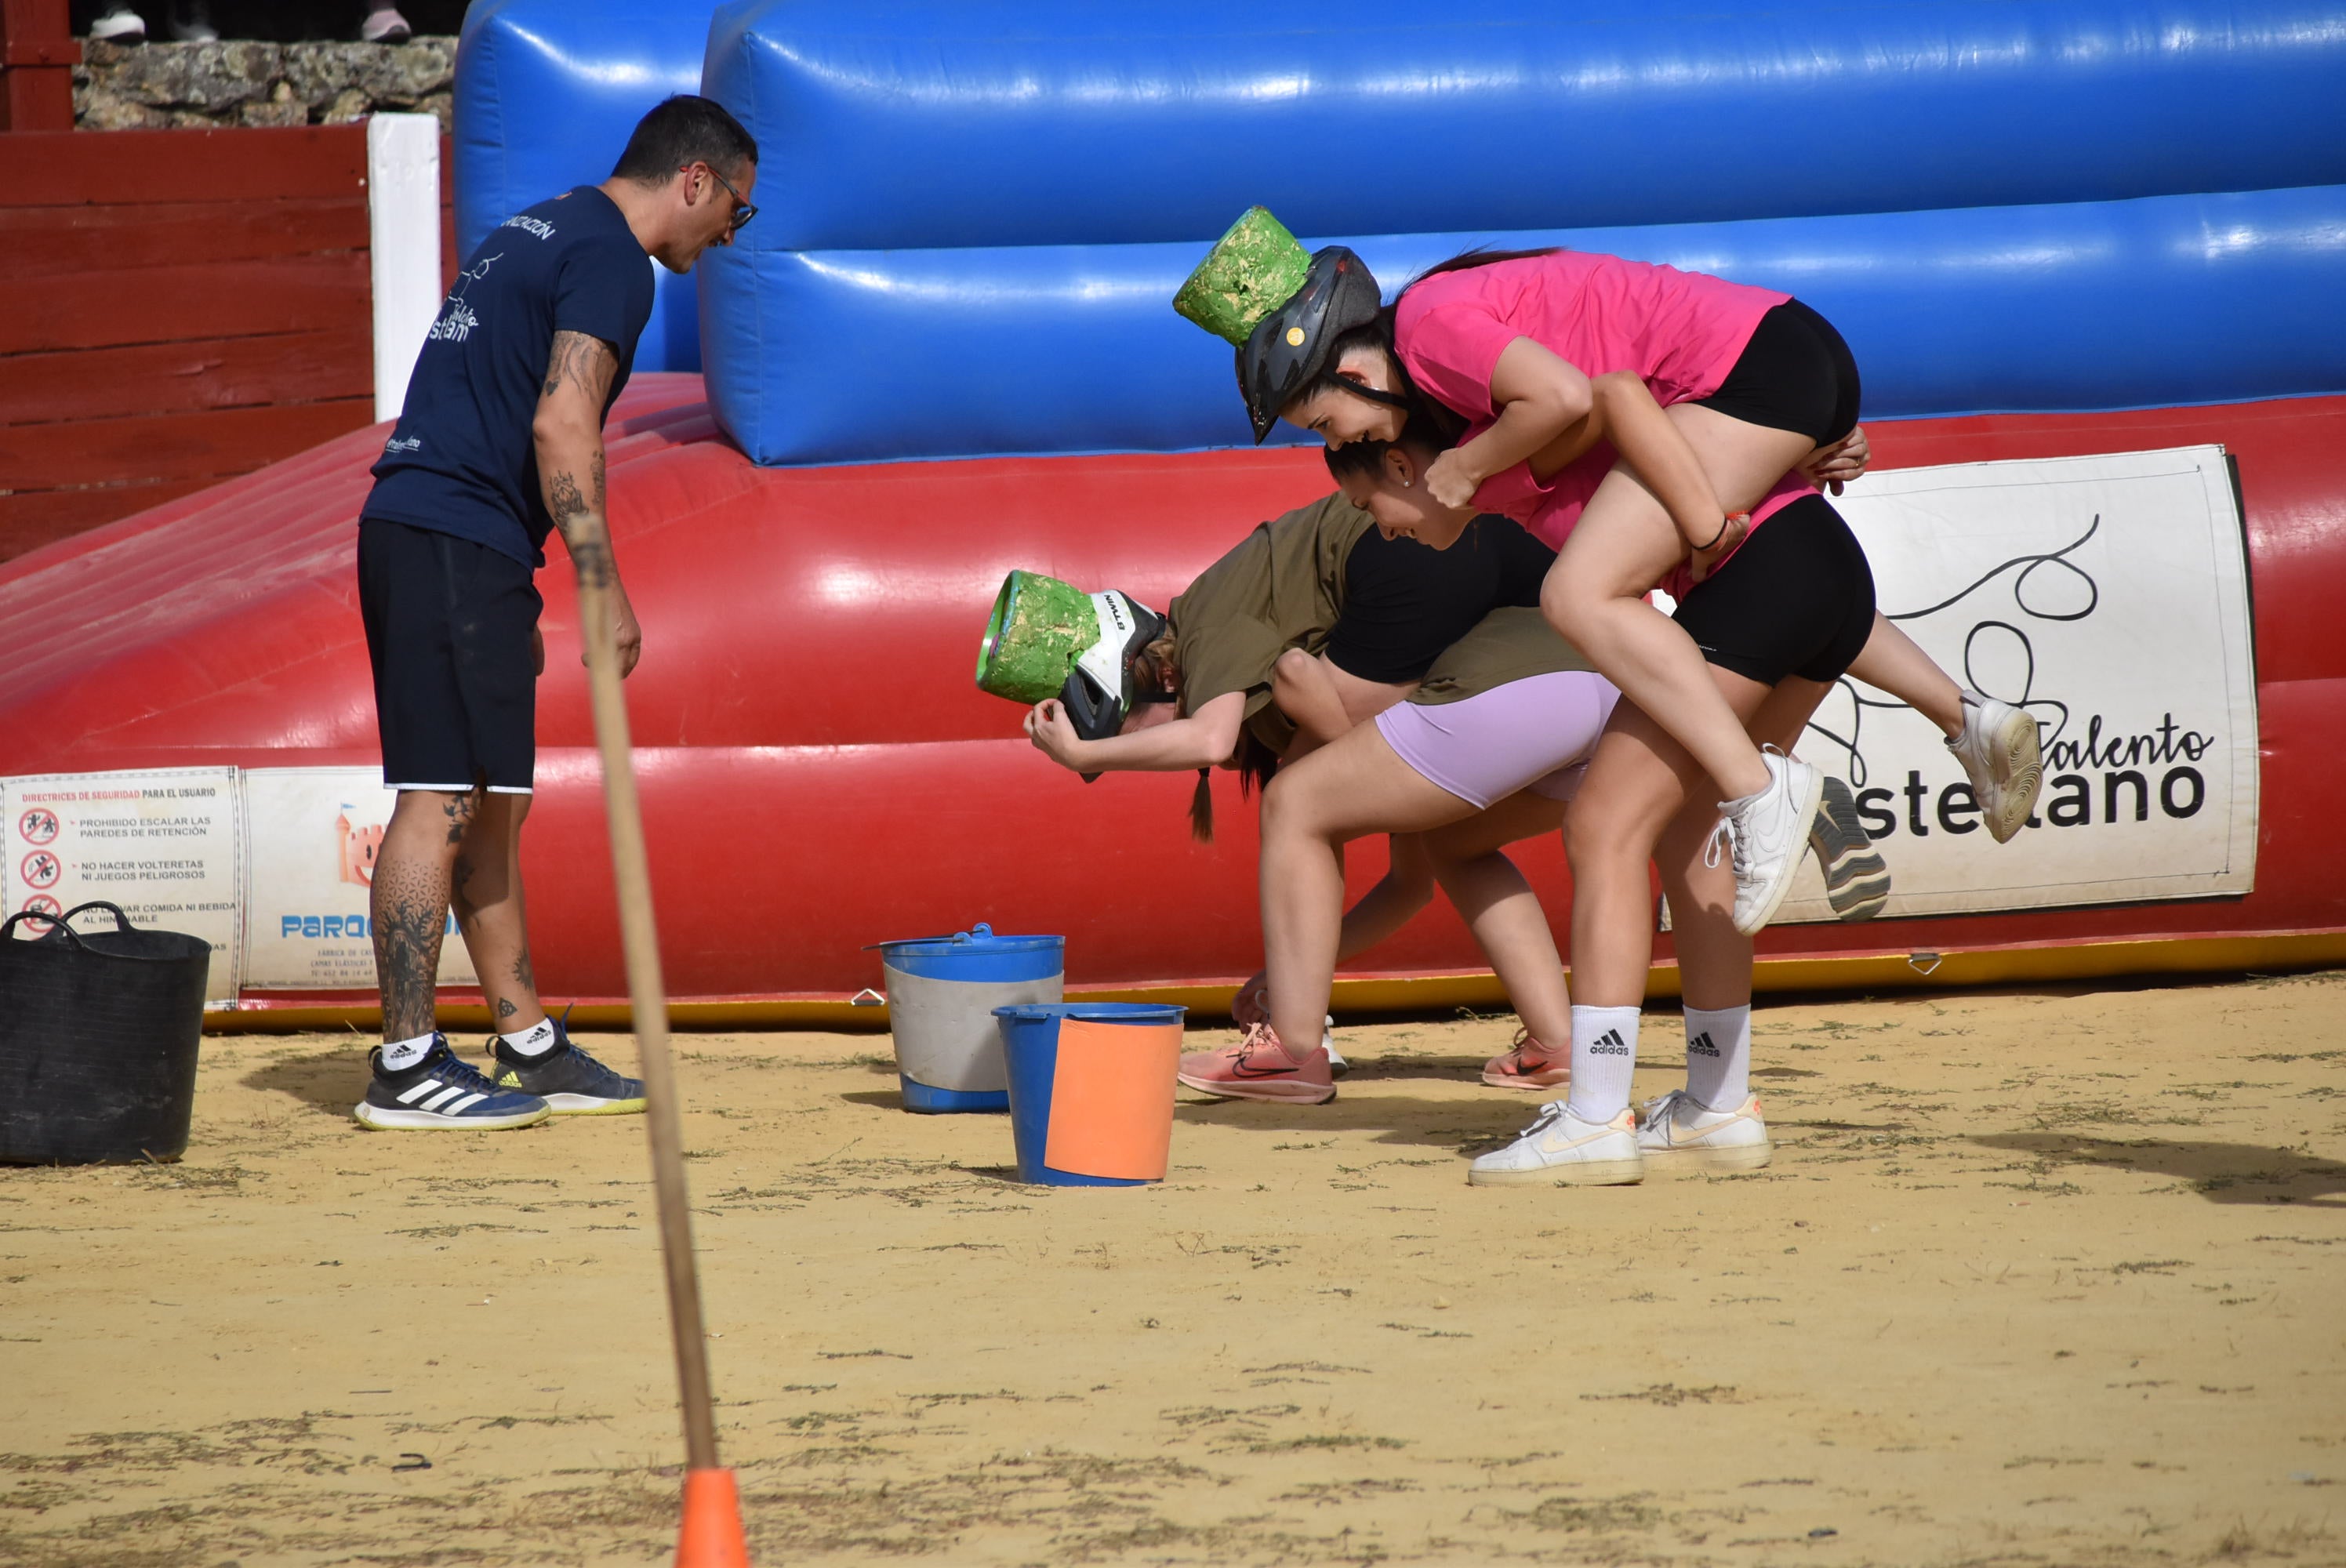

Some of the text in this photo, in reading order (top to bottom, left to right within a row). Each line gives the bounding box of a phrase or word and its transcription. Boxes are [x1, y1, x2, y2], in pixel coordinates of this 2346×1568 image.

[22, 787, 216, 803] DIRECTRICES DE SEGURIDAD PARA EL USUARIO
[1854, 765, 2206, 840] steano
[79, 816, 211, 828] PROHIBIDO ESCALAR LAS
[80, 826, 206, 838] PAREDES DE RETENCIÓN
[82, 860, 204, 870] NO HACER VOLTERETAS
[95, 872, 136, 880] JUEGOS
[140, 870, 205, 880] PELIGROSOS
[143, 903, 183, 913] COMIDA
[198, 902, 236, 911] BEBIDA
[99, 914, 158, 924] HINABLE
[1590, 1044, 1629, 1056] adidas
[1688, 1045, 1720, 1058] adidas
